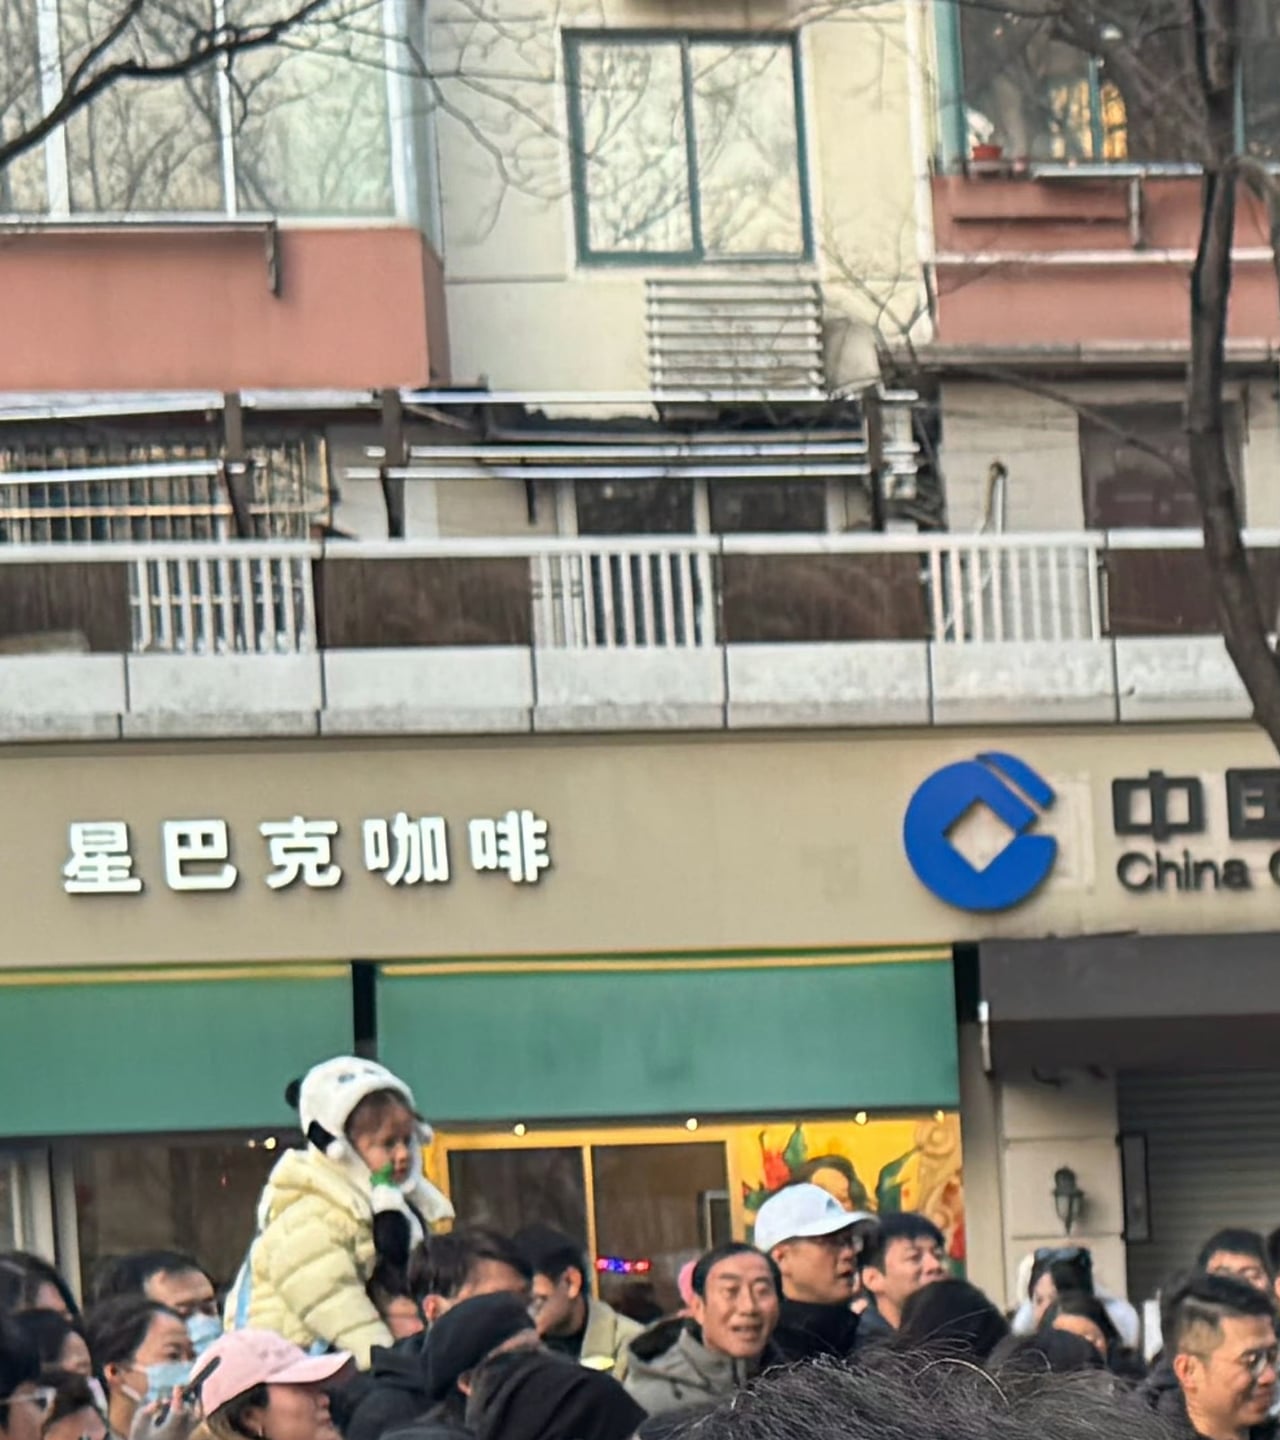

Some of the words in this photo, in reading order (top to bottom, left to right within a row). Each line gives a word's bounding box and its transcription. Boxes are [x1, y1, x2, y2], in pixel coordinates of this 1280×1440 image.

[63, 809, 551, 894] 星巴克咖啡
[1116, 848, 1252, 892] China
